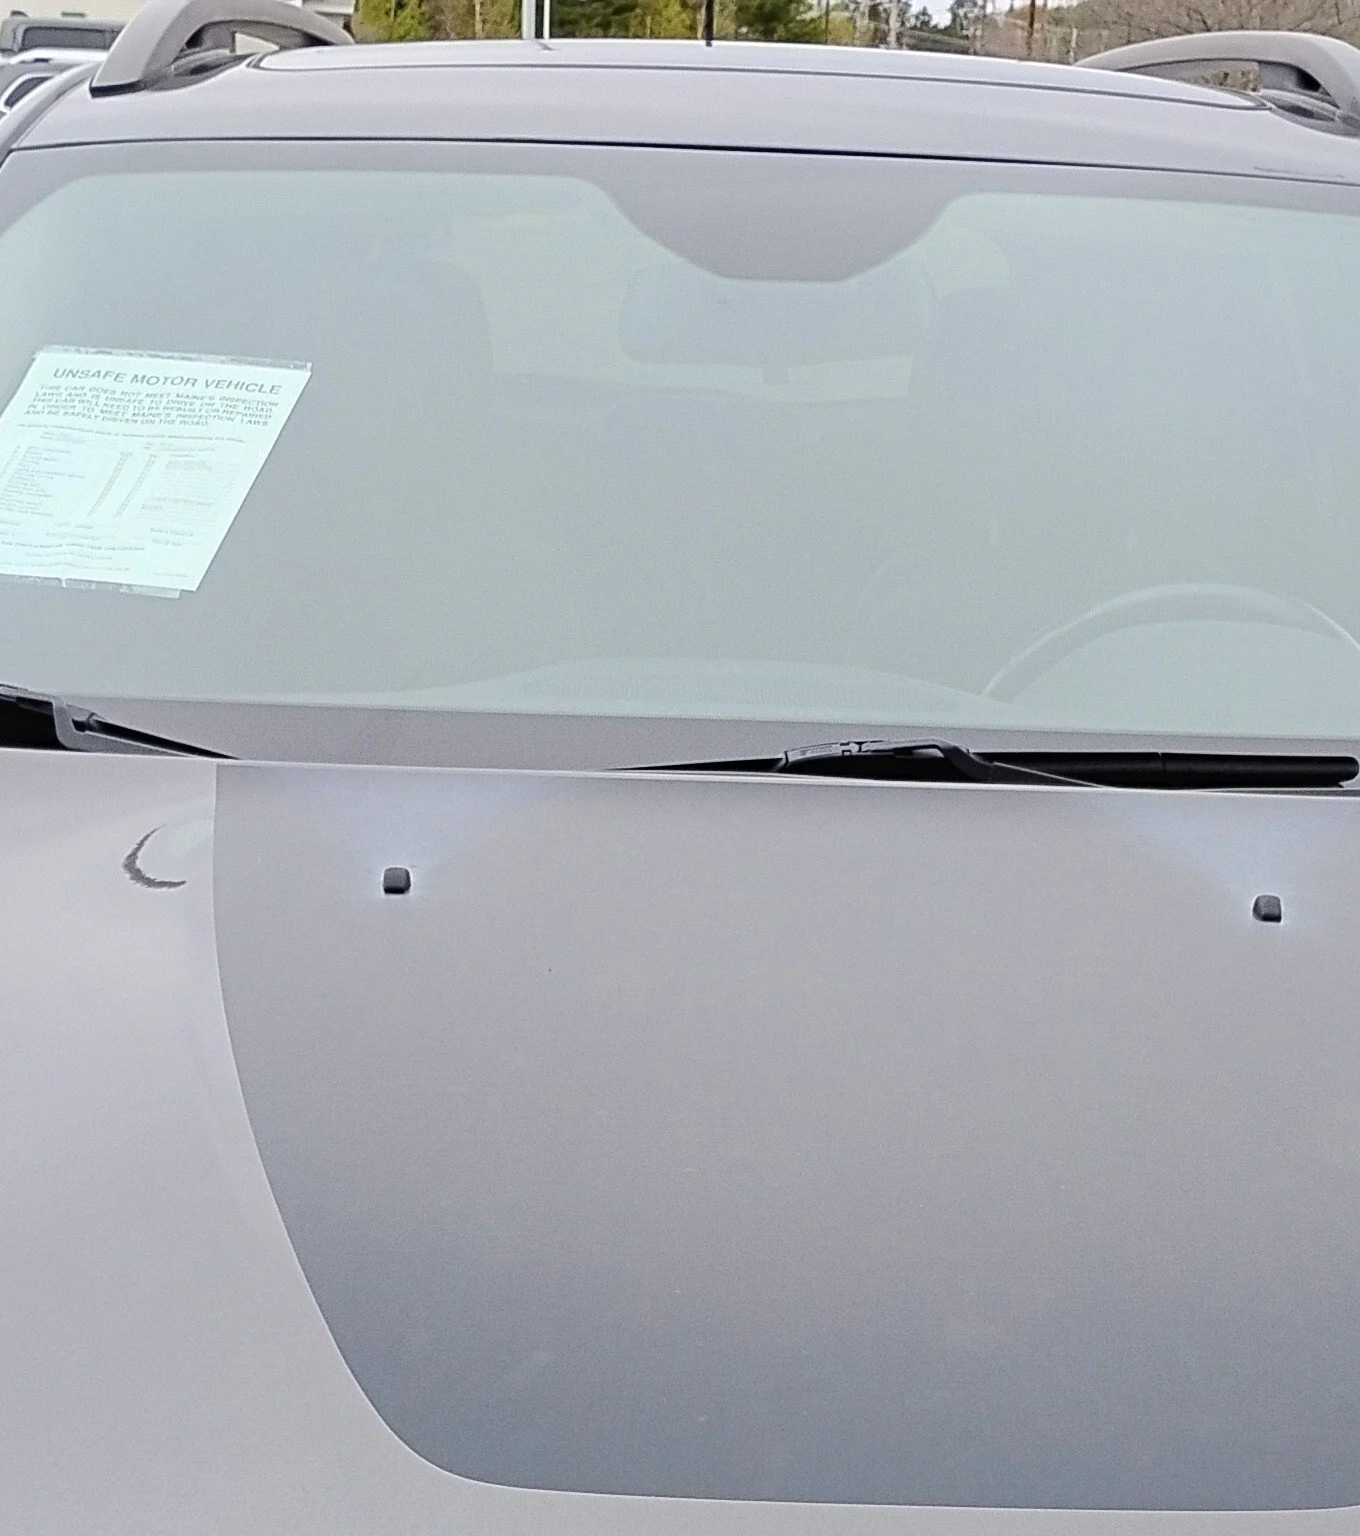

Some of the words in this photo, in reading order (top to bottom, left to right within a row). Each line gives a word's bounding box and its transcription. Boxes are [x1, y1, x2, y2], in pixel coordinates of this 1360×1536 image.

[53, 368, 127, 383] UNSAFE
[130, 374, 198, 388] MOTOR
[204, 379, 283, 395] VEHICLE
